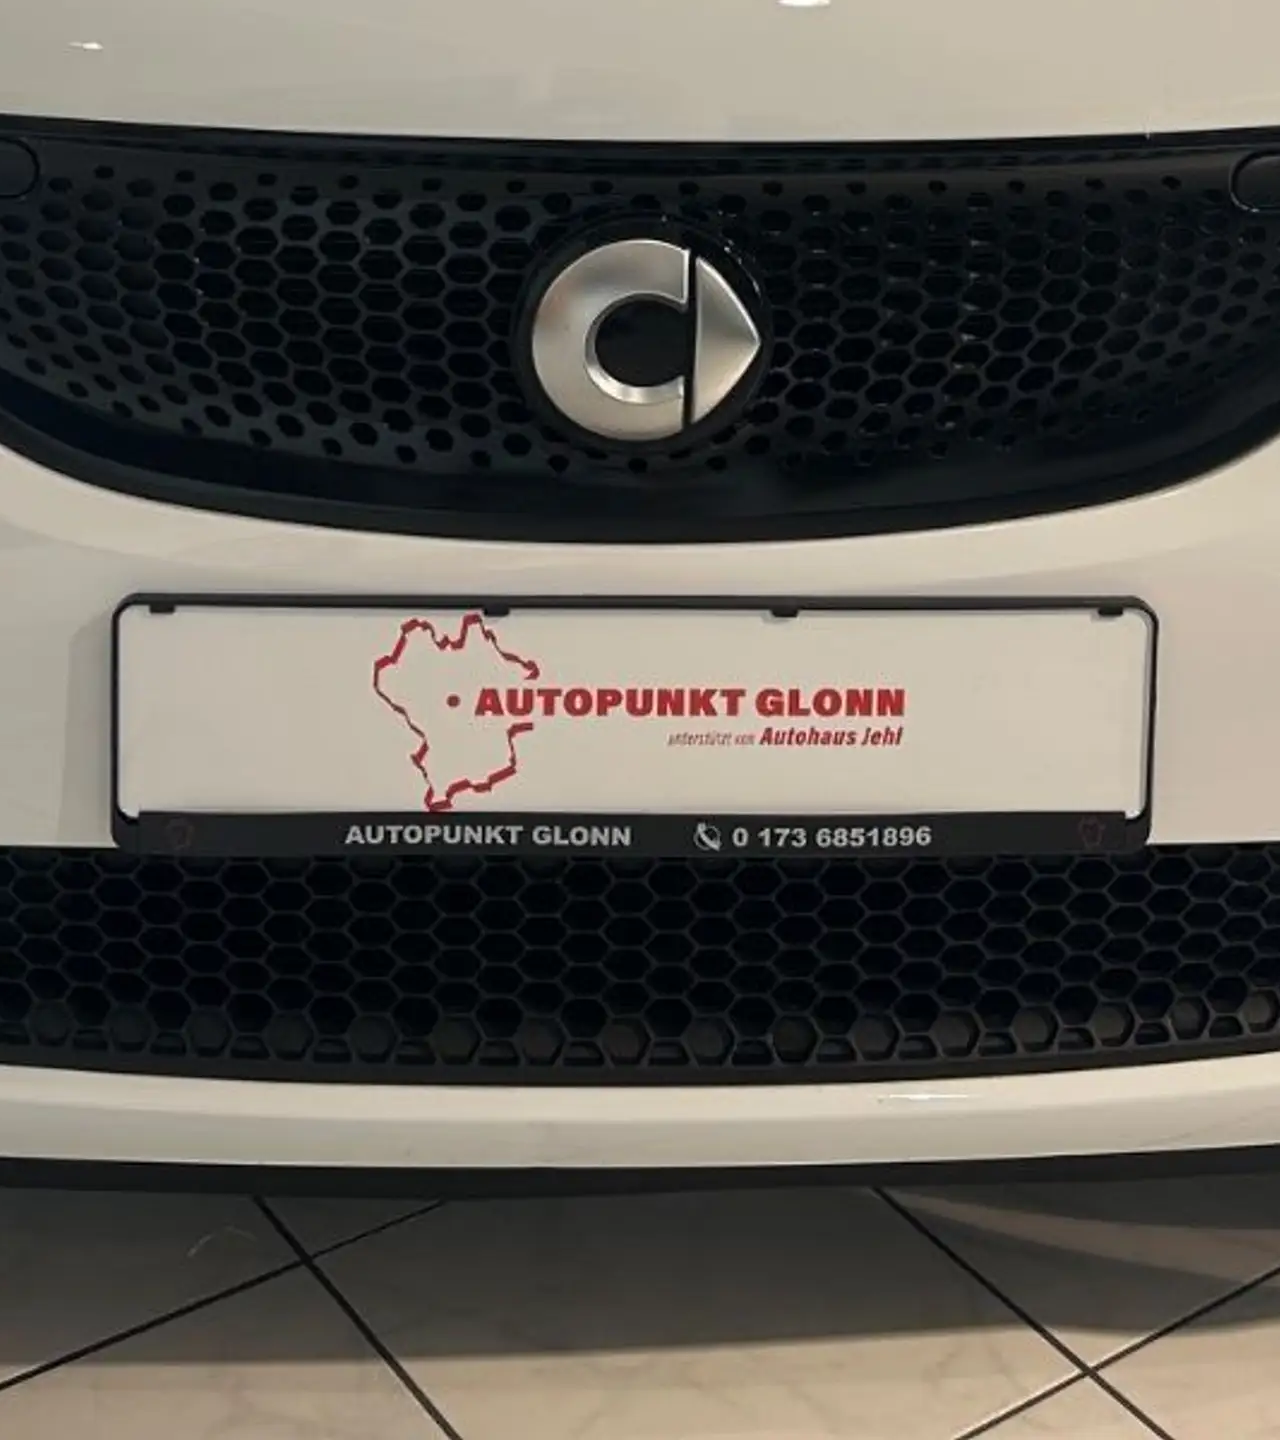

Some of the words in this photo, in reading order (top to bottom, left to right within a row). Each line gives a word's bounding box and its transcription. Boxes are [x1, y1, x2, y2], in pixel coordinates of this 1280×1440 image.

[474, 688, 746, 717] AUTOPUNKT
[755, 688, 905, 717] GLONN
[759, 726, 857, 747] Autohaus
[861, 726, 904, 747] Jehl
[345, 825, 523, 845] AUTOPUNKT
[532, 826, 632, 846] GLONN
[732, 827, 749, 848] 0
[758, 827, 807, 848] 173
[816, 826, 932, 848] 6851896
